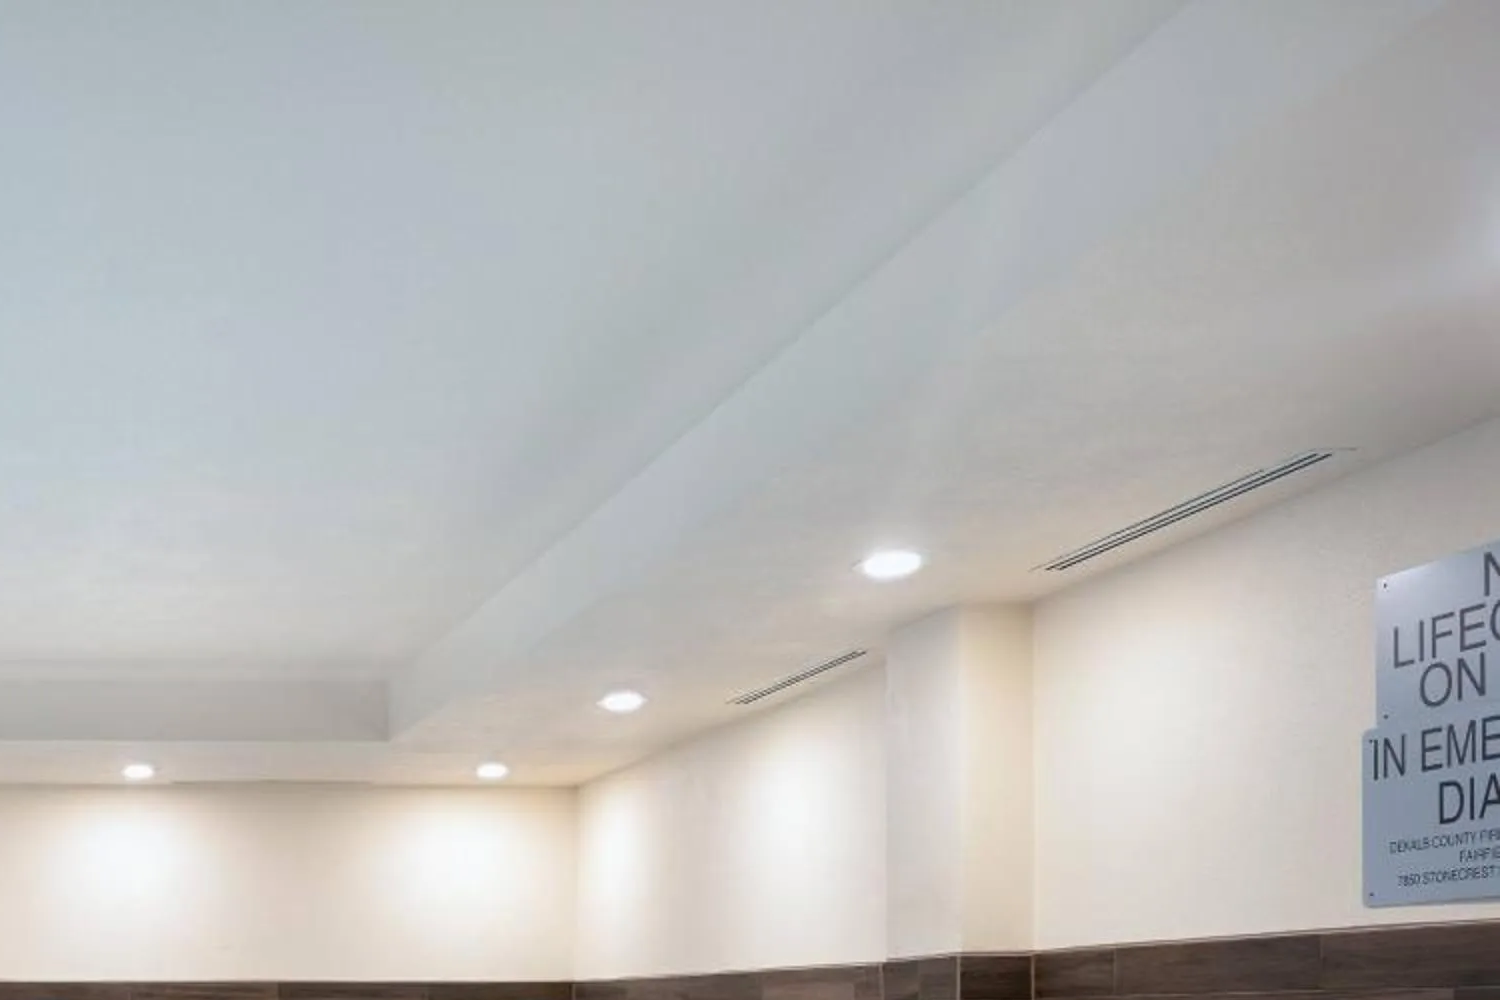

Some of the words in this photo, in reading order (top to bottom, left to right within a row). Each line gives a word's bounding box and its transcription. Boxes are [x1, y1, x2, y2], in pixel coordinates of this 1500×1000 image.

[1420, 652, 1486, 708] ON
[1372, 733, 1406, 781] IN
[1431, 831, 1477, 849] COUNTY
